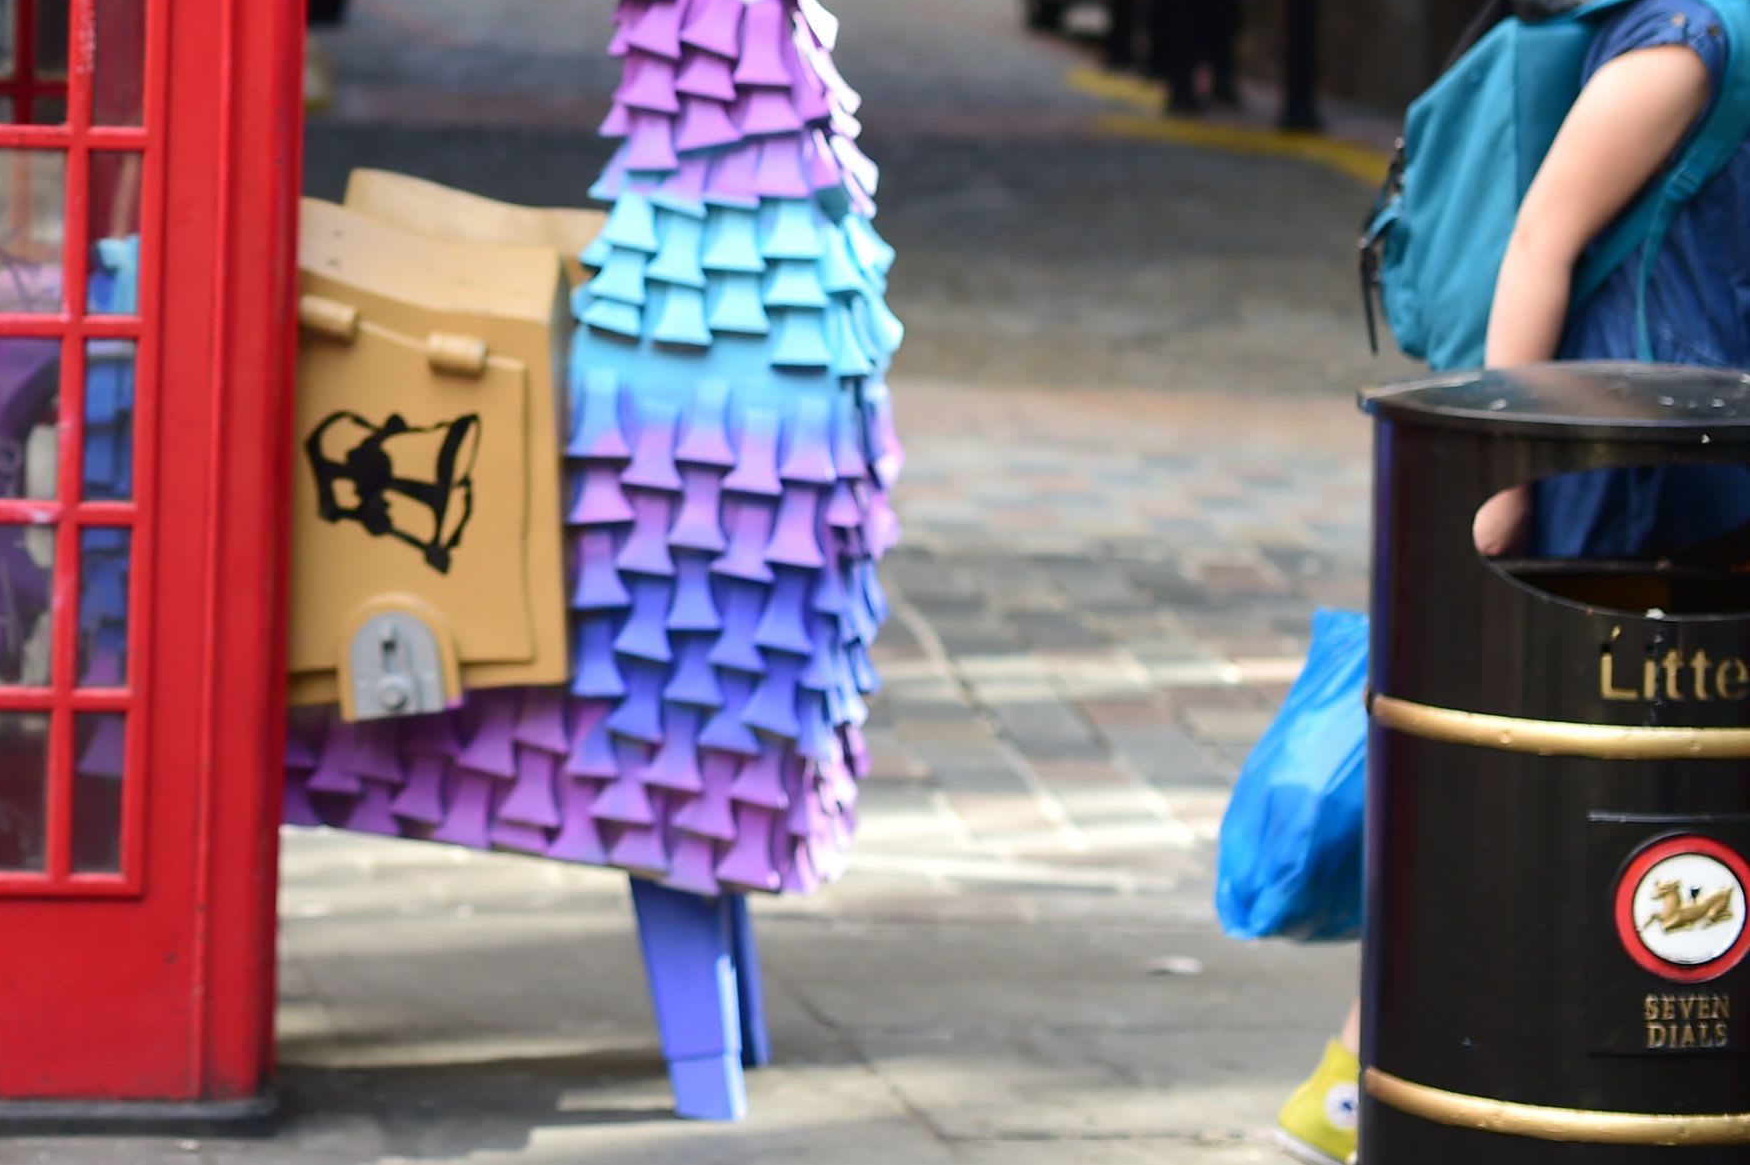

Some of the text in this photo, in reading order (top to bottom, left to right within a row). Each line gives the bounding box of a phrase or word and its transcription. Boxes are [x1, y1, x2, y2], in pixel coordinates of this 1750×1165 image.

[1601, 642, 1749, 702] Litte
[1643, 993, 1730, 1020] SEVEN
[1645, 1022, 1728, 1048] DIALS
